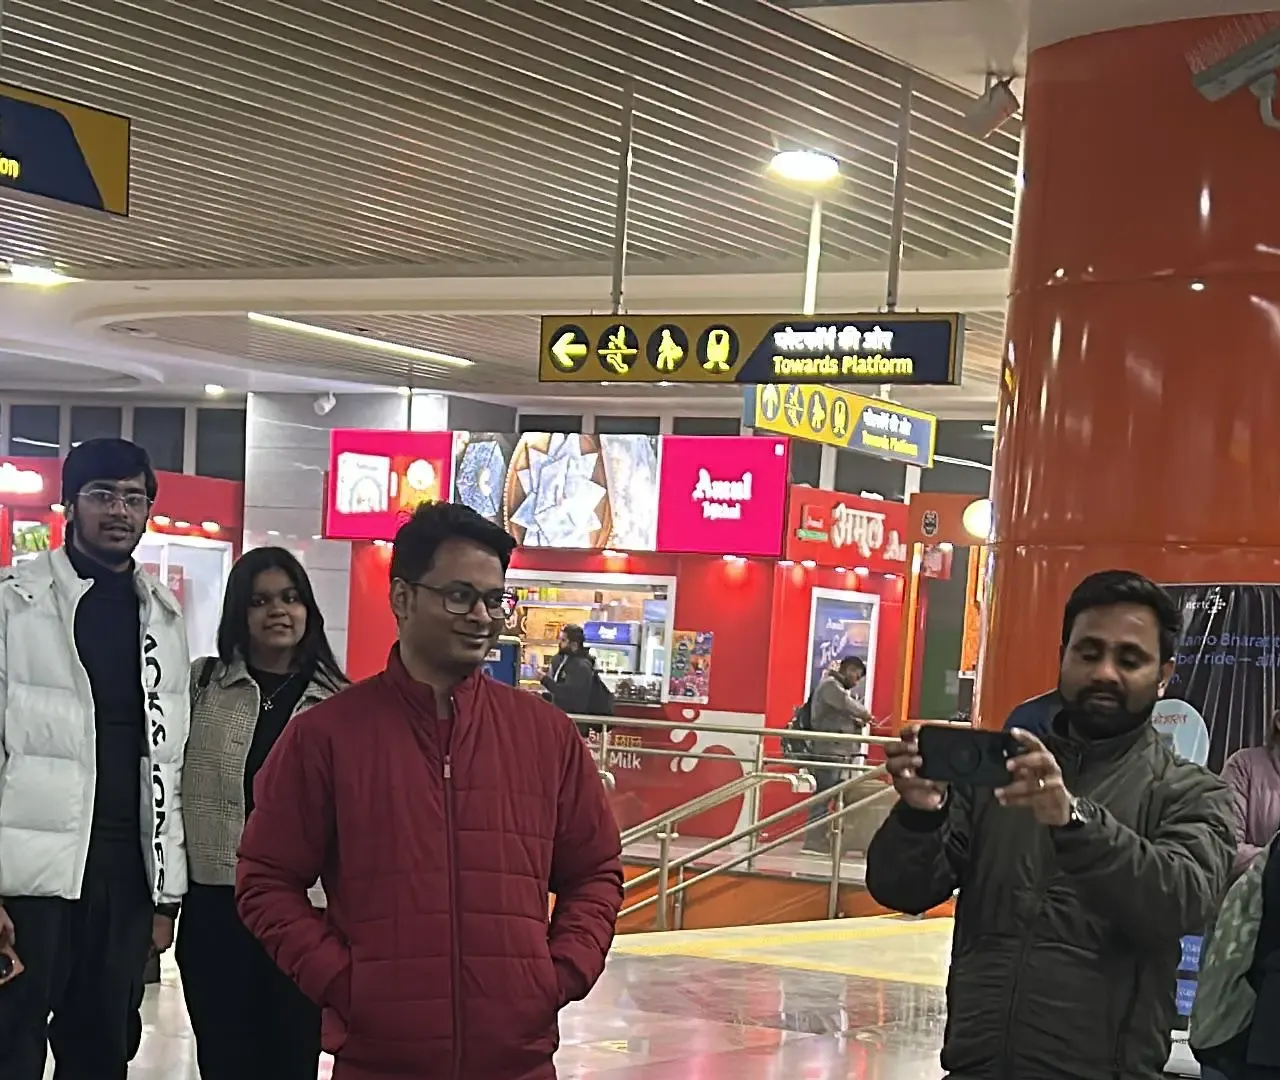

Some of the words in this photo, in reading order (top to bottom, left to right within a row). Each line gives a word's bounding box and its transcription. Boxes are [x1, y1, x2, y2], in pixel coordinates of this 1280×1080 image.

[773, 354, 839, 375] Towards
[841, 354, 913, 375] Platform
[830, 502, 886, 559] अमूल
[1220, 633, 1271, 649] Bharat
[1204, 652, 1236, 666] ride
[1255, 654, 1274, 668] all
[609, 751, 642, 769] Milk
